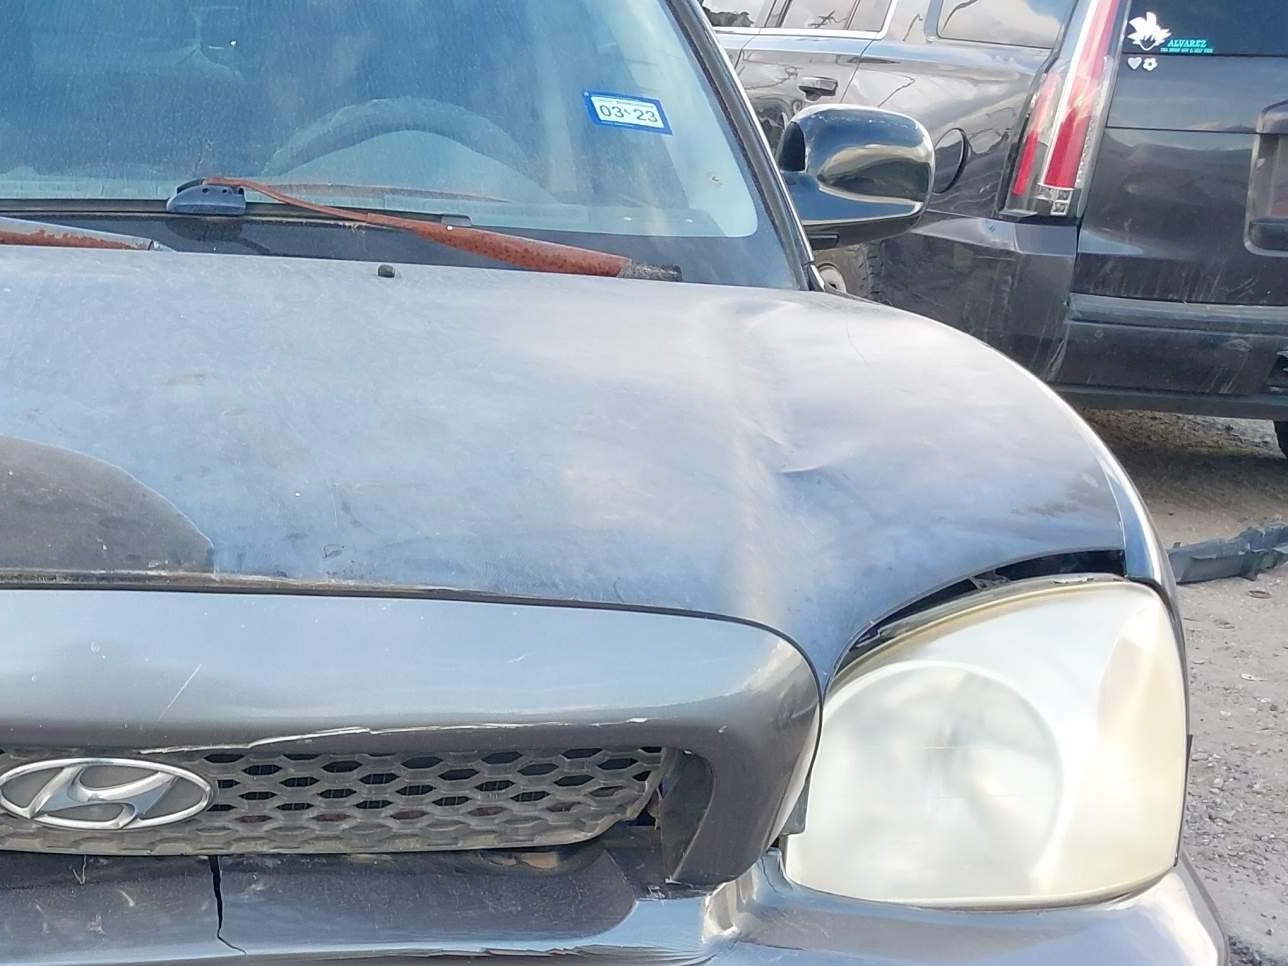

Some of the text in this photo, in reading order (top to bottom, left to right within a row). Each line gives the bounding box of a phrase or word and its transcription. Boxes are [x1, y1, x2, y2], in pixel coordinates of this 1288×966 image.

[1167, 39, 1208, 48] ALVAREZ
[599, 104, 625, 118] 03
[633, 108, 658, 123] 23
